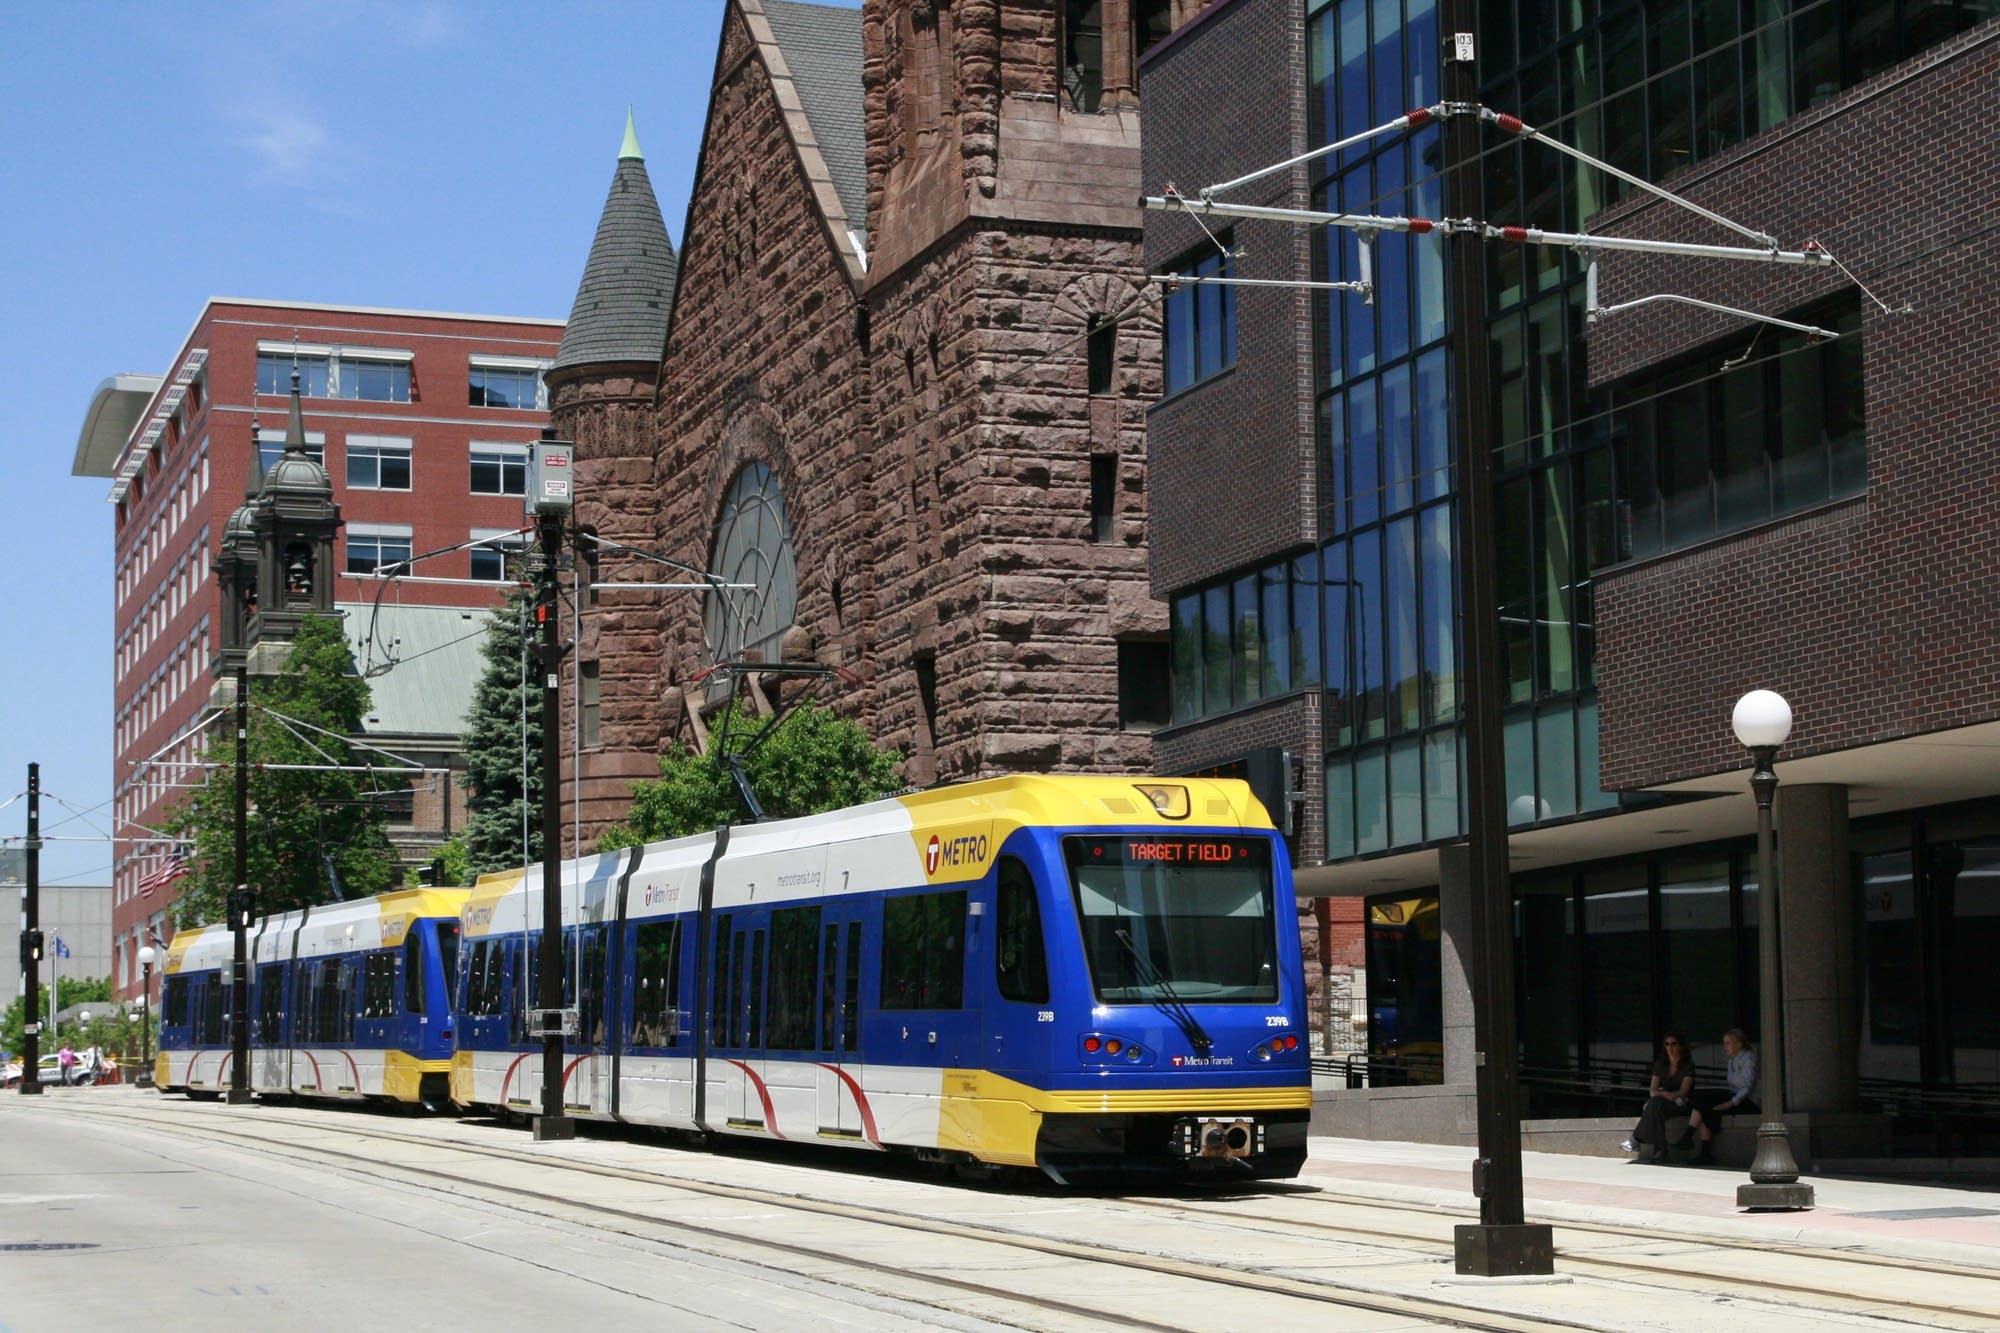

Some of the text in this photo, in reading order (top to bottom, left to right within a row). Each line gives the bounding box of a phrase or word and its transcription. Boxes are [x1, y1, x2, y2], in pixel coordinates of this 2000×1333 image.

[1456, 35, 1472, 45] 103
[942, 835, 987, 867] METRO
[1129, 843, 1232, 861] TARGET FIELD
[777, 871, 821, 888] metrotransit.org
[473, 907, 491, 925] METRO
[1038, 1011, 1055, 1022] 239B
[1265, 1016, 1289, 1027] 239B
[1184, 1056, 1209, 1066] Metro
[1209, 1056, 1233, 1066] Transit
